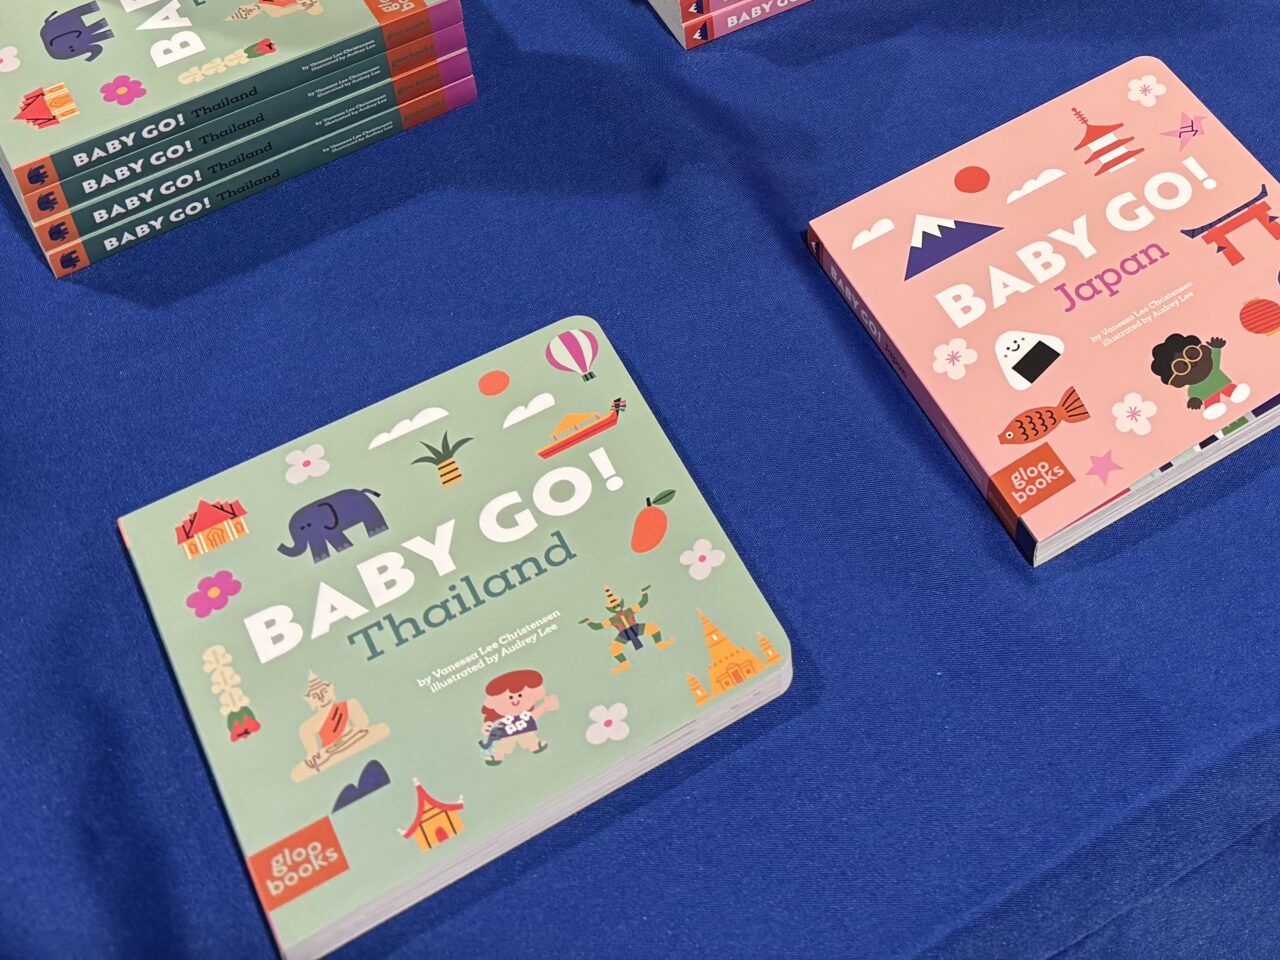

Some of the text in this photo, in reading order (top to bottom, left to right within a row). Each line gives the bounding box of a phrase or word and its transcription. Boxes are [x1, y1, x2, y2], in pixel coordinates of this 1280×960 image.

[727, 0, 773, 28] BABY
[73, 86, 258, 167] BABY GO! Thailand
[82, 112, 265, 194] BABY GO! Thailand
[93, 141, 273, 224] BABY GO! Thailand
[104, 168, 281, 251] BABY GO! Thailand
[934, 155, 1217, 329] BABY GO!
[1054, 240, 1170, 314] Japan
[830, 265, 882, 343] BABY GO!
[1011, 462, 1049, 489] glop
[1011, 466, 1064, 504] books
[242, 447, 624, 665] BABY GO!
[348, 531, 576, 661] Thailand
[417, 610, 561, 688] by Vanessa Lee Christensen
[429, 623, 558, 692] illustrated by Audrey Lee
[266, 848, 338, 896] books
[271, 841, 321, 877] glop
